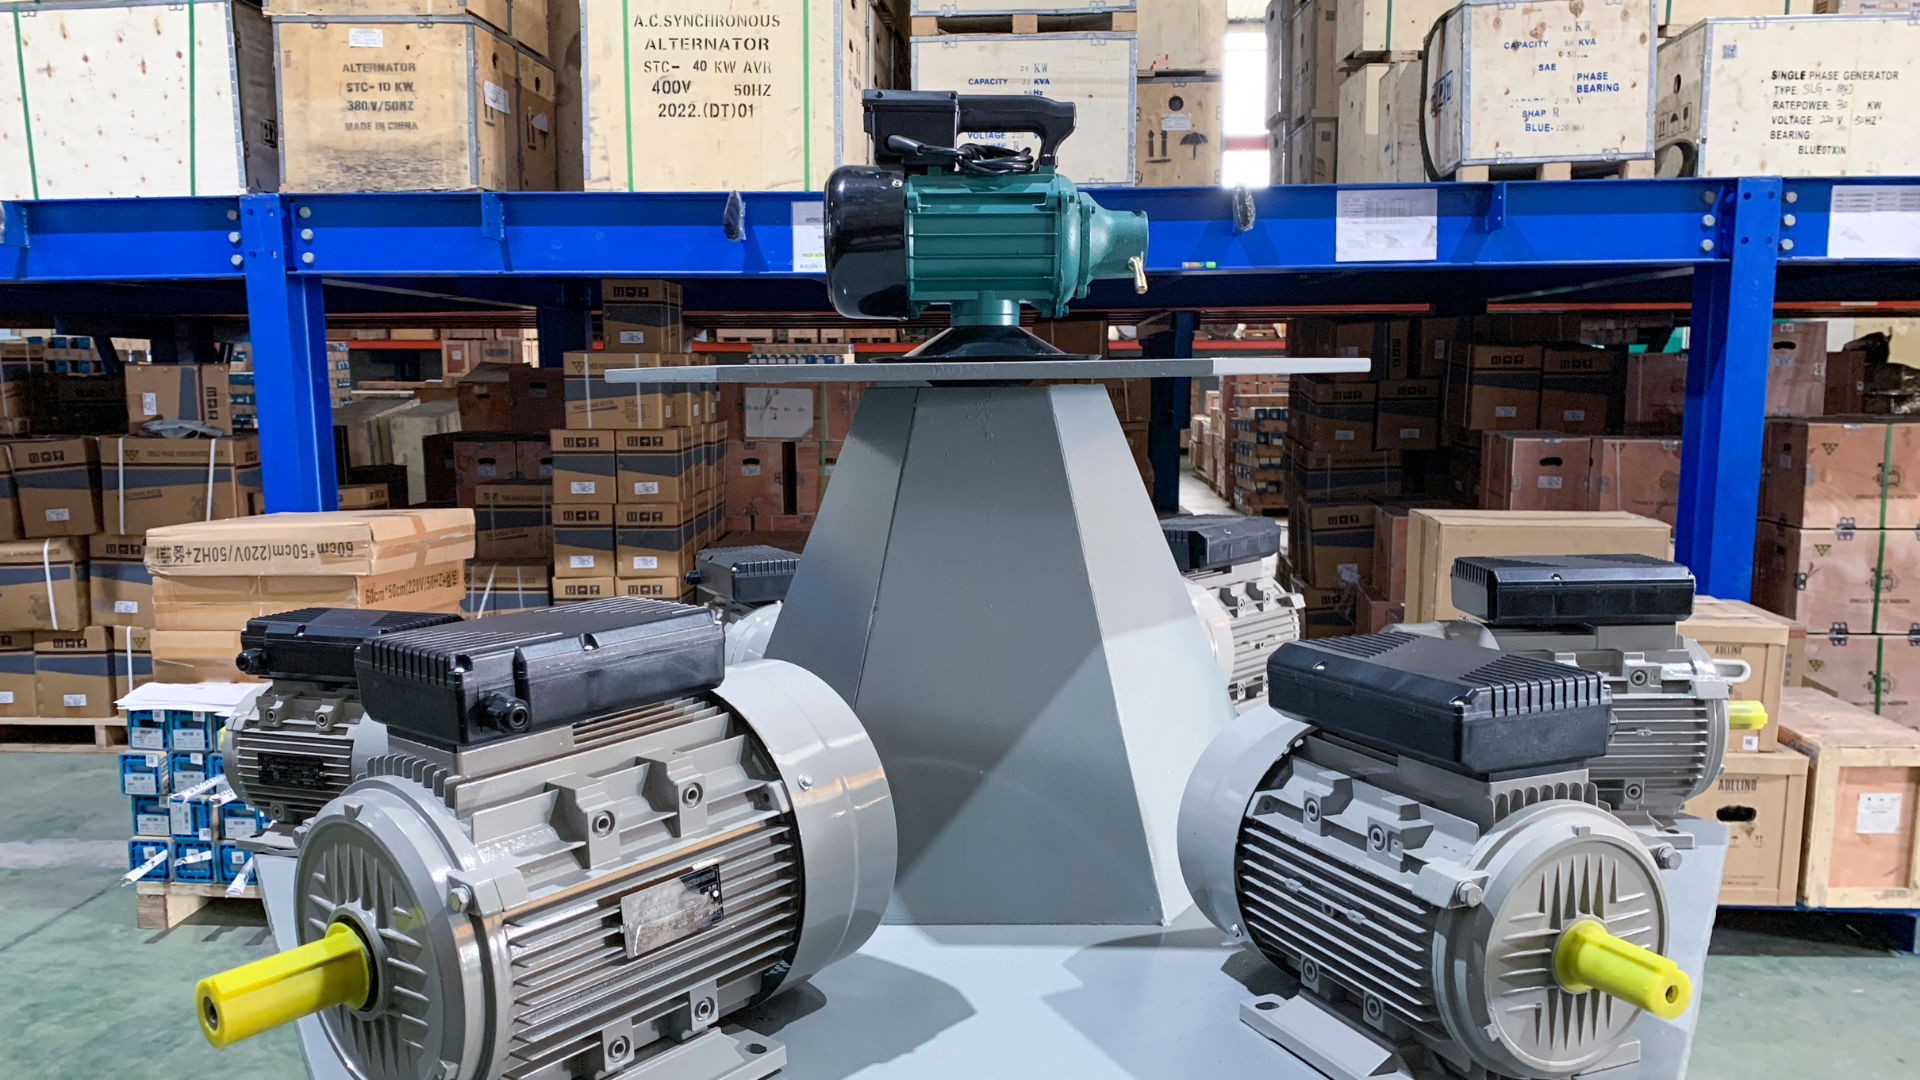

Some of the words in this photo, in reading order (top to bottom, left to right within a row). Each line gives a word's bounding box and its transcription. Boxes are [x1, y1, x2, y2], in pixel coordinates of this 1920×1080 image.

[634, 14, 781, 28] A.C.SYNCHRONOUS
[1575, 21, 1592, 32] KW
[645, 38, 770, 51] ALTERNATOR
[1503, 40, 1549, 50] CAPACITY
[1578, 38, 1597, 46] KVA
[342, 62, 416, 73] ALTERNATOR
[643, 60, 680, 73] STC-
[693, 60, 708, 72] 40
[714, 60, 737, 74] KW
[743, 60, 772, 74] AVR
[1033, 63, 1049, 74] KW
[1538, 63, 1557, 71] SAE
[1577, 71, 1609, 81] PHASE
[1771, 70, 1806, 80] SINGLE
[1808, 71, 1839, 80] PHASE
[1843, 71, 1900, 80] GENERATOR
[377, 82, 391, 92] 10
[395, 82, 414, 92] KW
[651, 79, 691, 94] 400V
[734, 84, 772, 96] 50HZ
[1576, 83, 1620, 93] BEARING
[658, 103, 754, 118] 2022.(DT)01
[1867, 101, 1882, 110] KW
[1521, 109, 1546, 118] SHAP
[344, 122, 372, 131] MADE
[375, 122, 385, 131] IN
[1718, 778, 1758, 791] ADELINO
